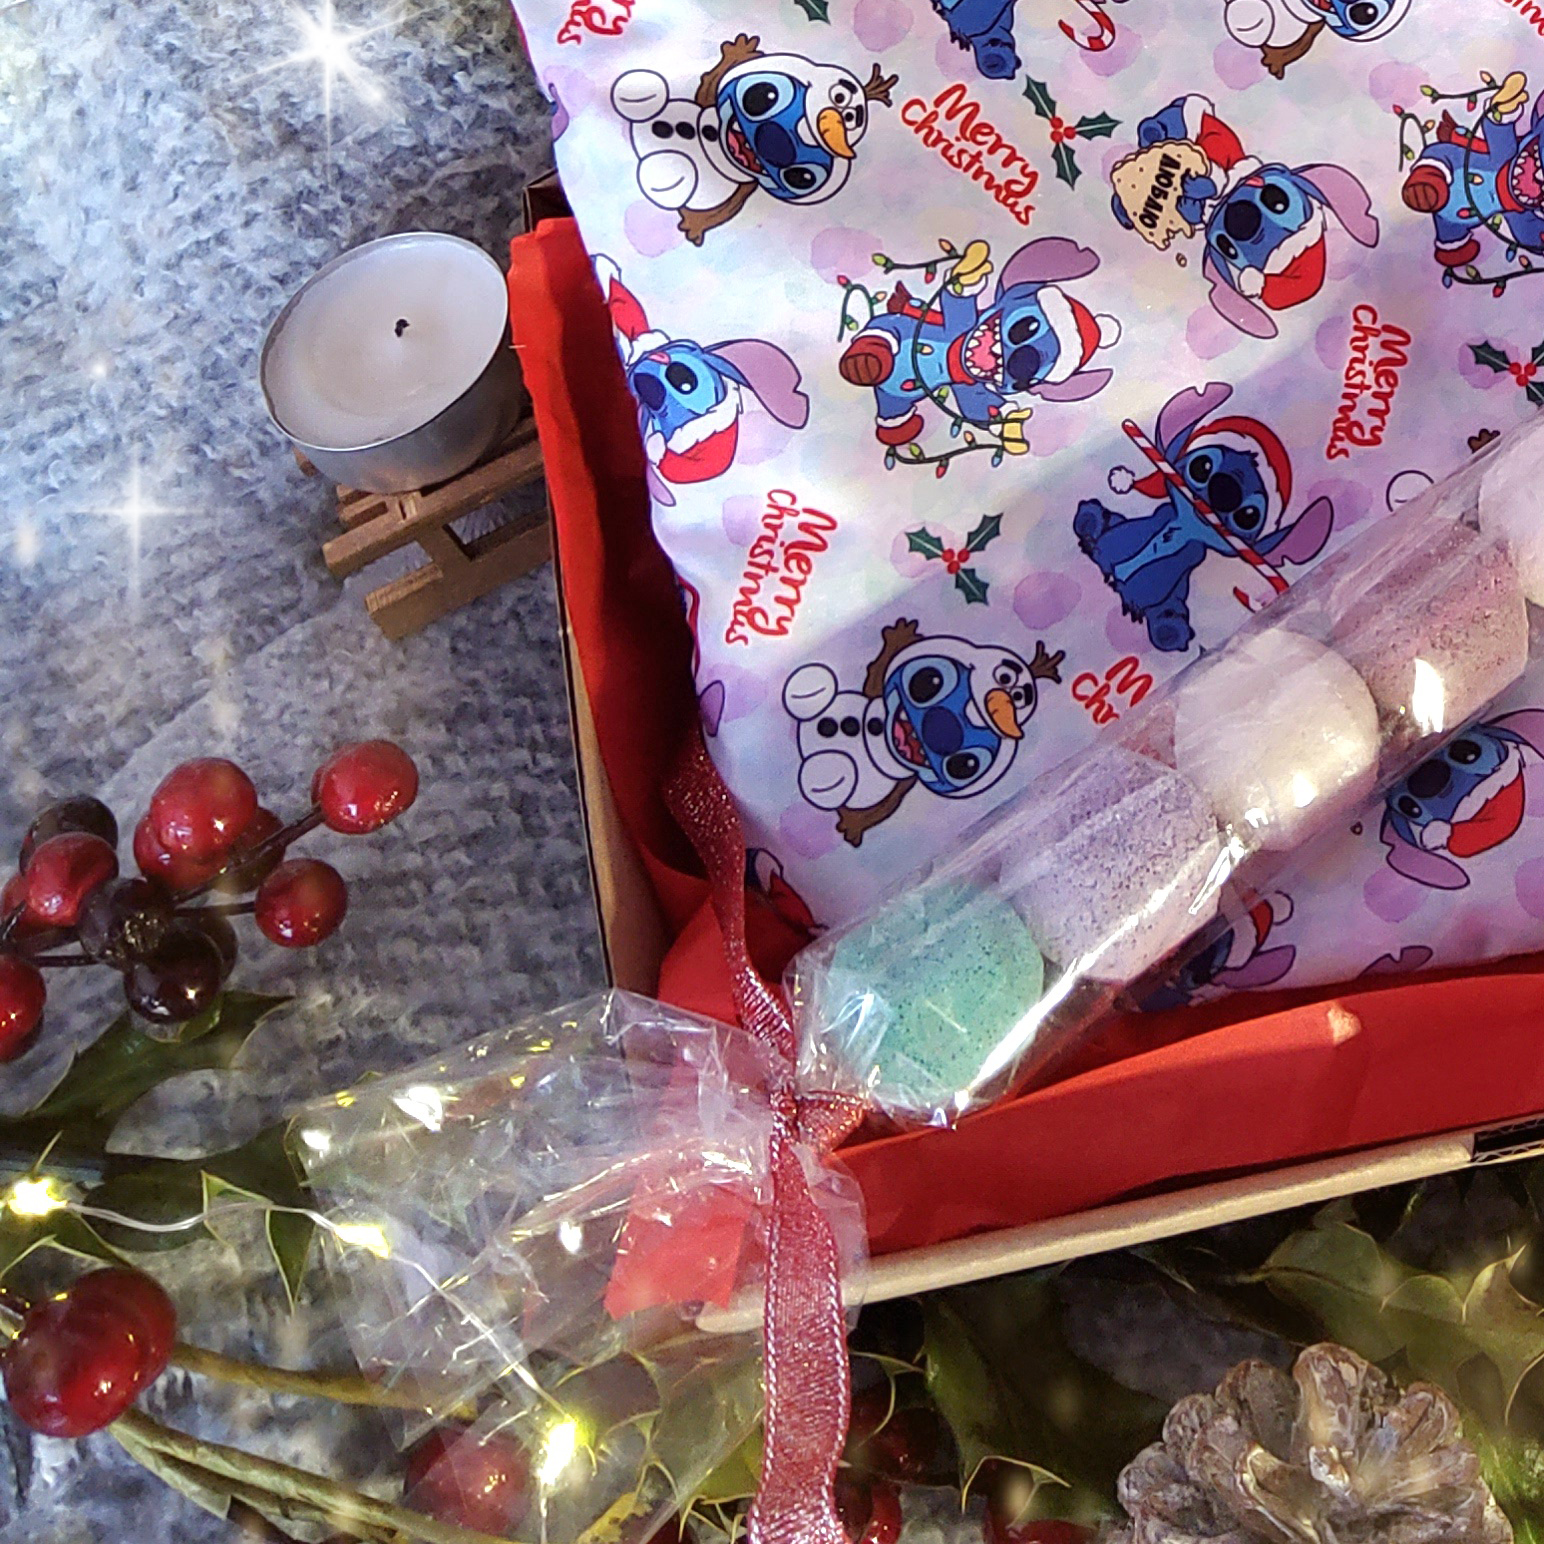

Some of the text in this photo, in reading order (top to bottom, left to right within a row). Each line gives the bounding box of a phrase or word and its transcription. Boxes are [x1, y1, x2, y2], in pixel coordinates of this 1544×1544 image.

[901, 97, 1036, 227] Christmas
[933, 82, 1039, 199] Merry
[1325, 304, 1382, 461] Christmas
[1345, 323, 1411, 447] Merry
[725, 488, 800, 646] Christmas
[744, 507, 838, 636] Merry
